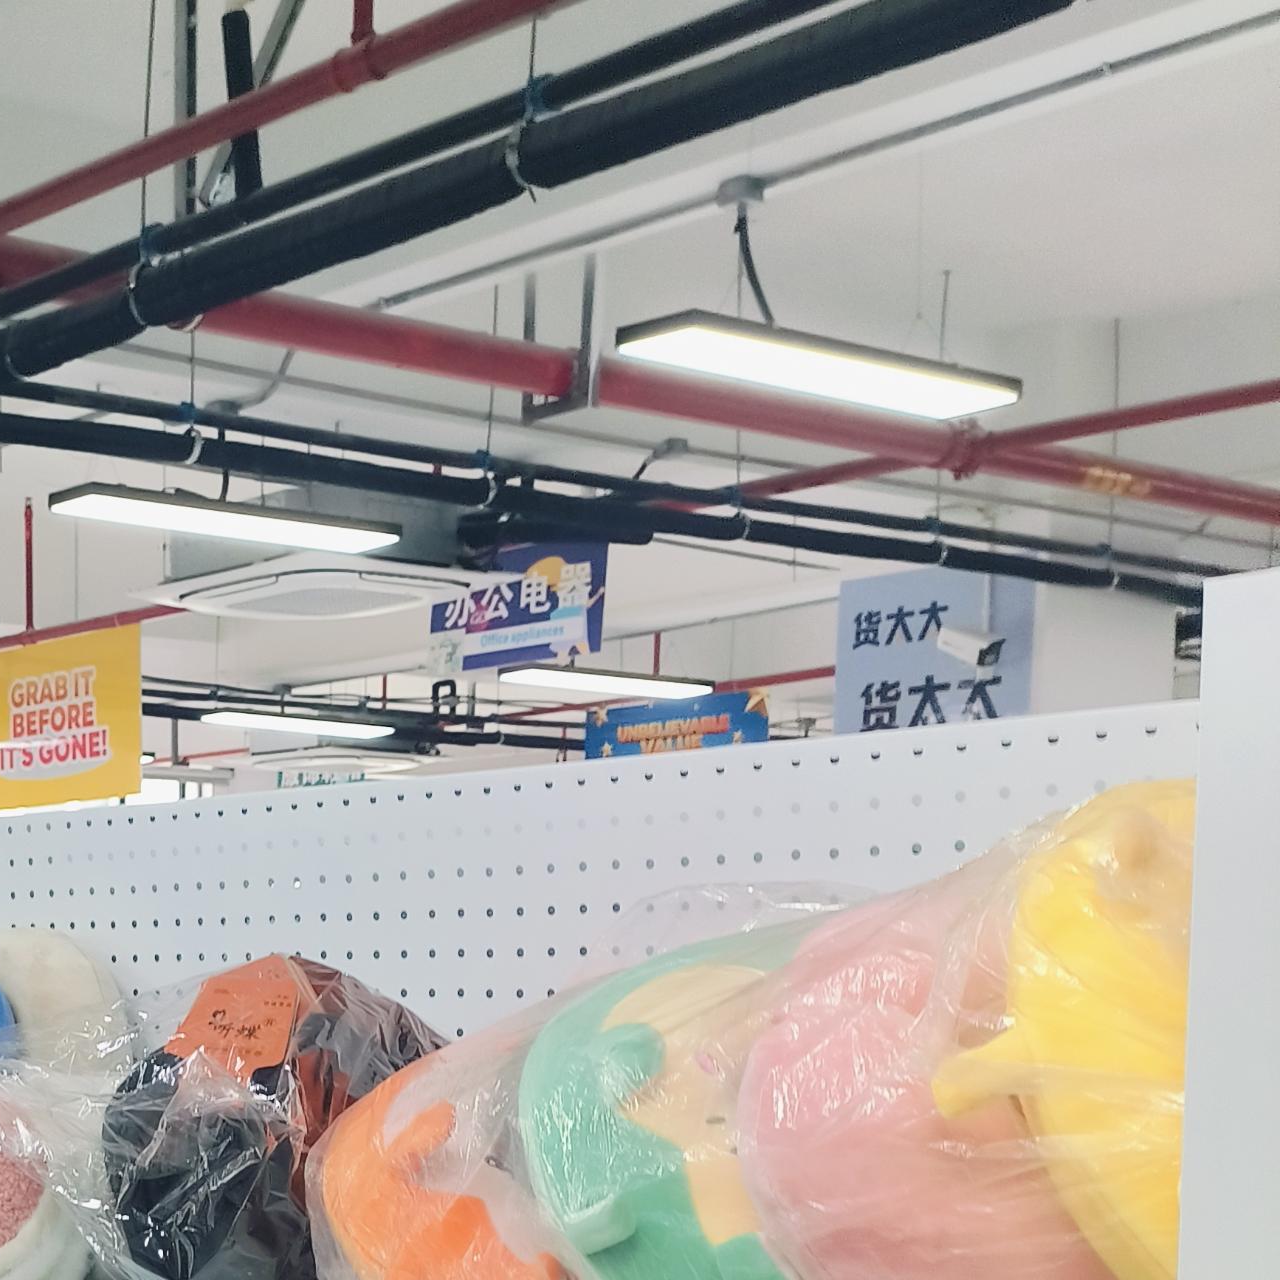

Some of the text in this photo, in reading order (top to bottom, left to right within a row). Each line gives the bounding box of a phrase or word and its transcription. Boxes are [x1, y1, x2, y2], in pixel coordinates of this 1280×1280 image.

[445, 562, 592, 628] 办公电器
[480, 625, 565, 648] Office appliances
[852, 601, 949, 650] 货大大
[10, 668, 95, 709] GRAB IT
[11, 700, 95, 739] BEFORE
[616, 713, 730, 744] UNBELIEVABLE
[38, 728, 108, 766] GONE!
